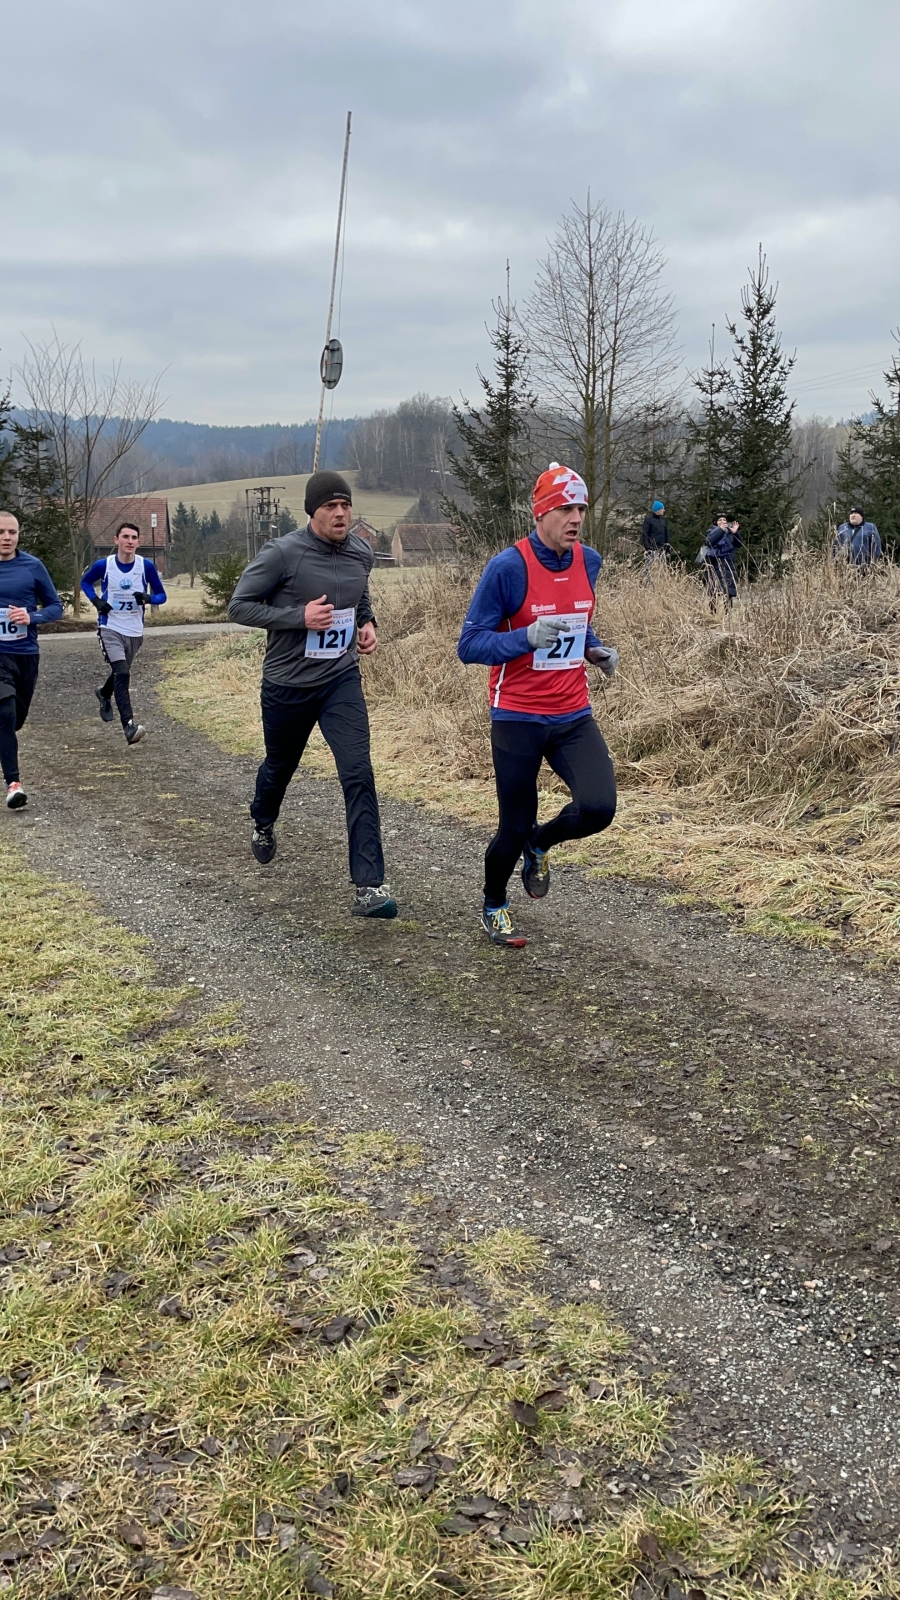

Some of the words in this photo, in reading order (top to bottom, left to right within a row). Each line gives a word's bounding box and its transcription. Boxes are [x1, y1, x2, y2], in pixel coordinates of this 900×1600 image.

[118, 601, 134, 611] 73
[0, 621, 18, 634] 16
[317, 629, 347, 649] 121
[547, 636, 575, 659] 27
